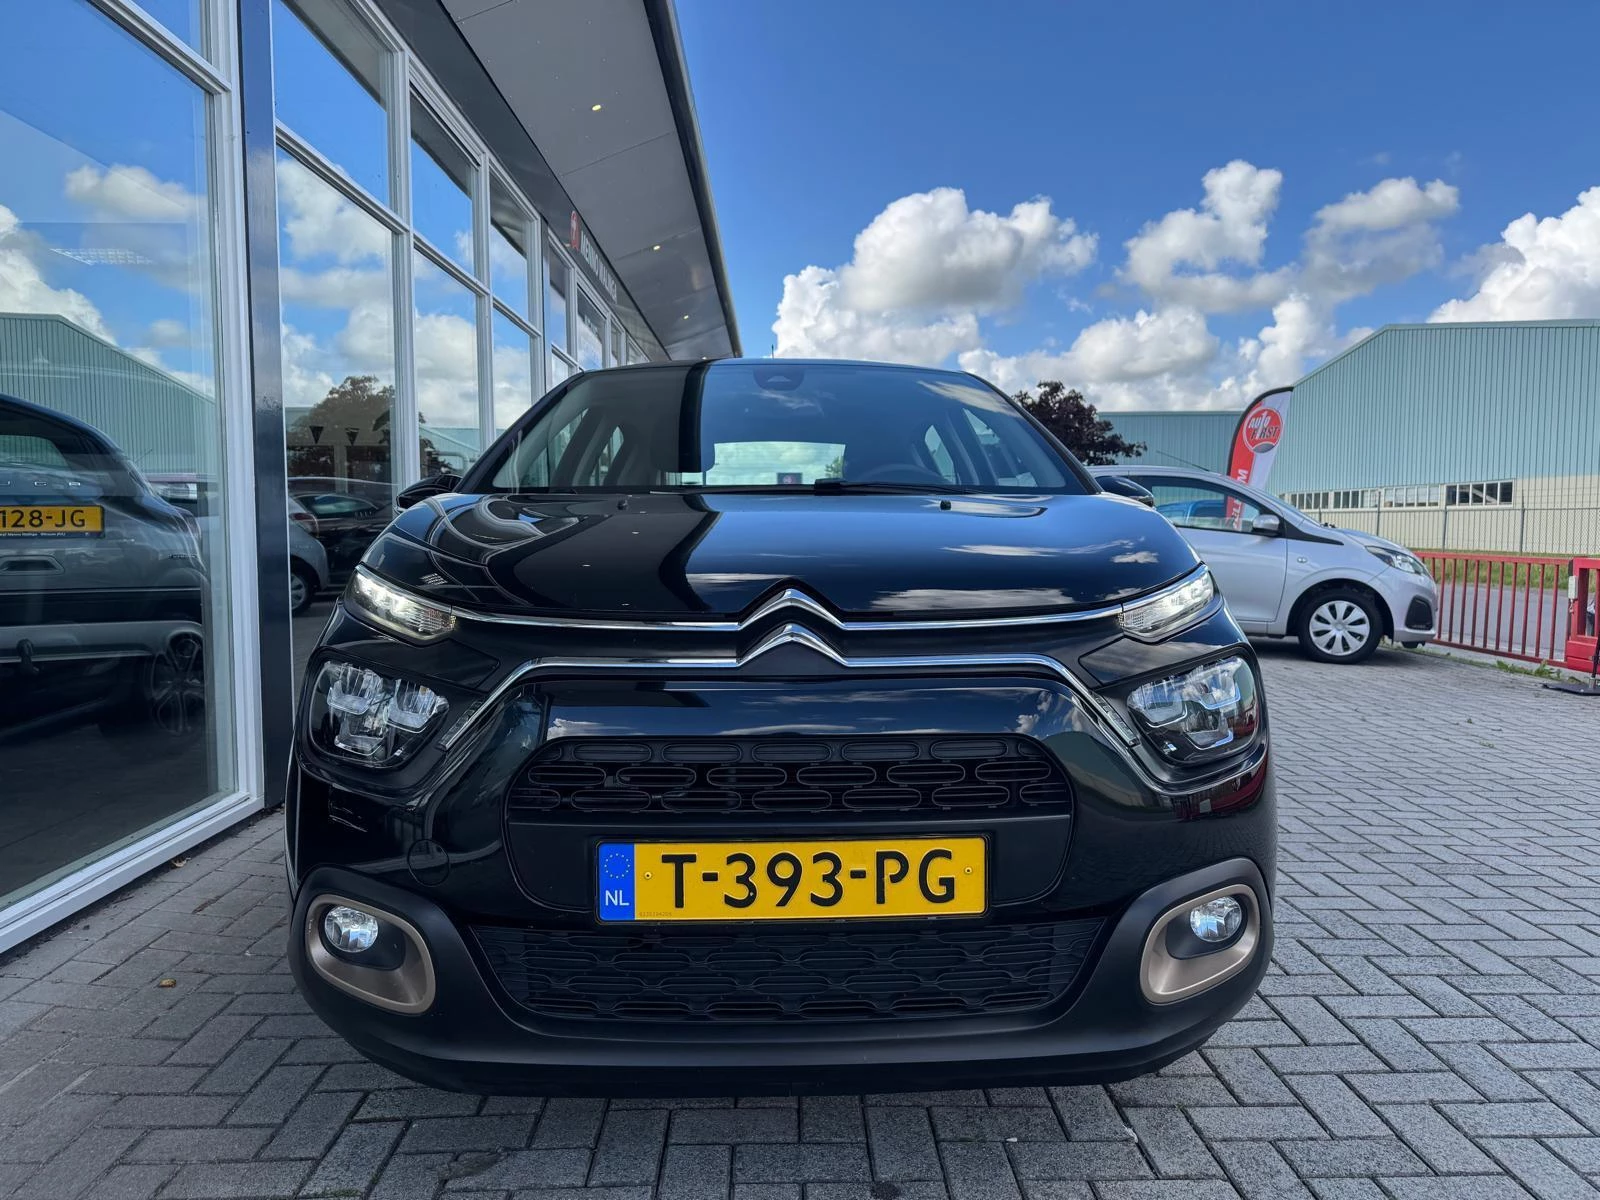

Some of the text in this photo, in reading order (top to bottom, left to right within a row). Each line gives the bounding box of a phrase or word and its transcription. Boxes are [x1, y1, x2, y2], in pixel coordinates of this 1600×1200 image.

[0, 509, 86, 528] 128-JG
[661, 848, 955, 909] T-393-PG
[605, 889, 629, 906] NL
